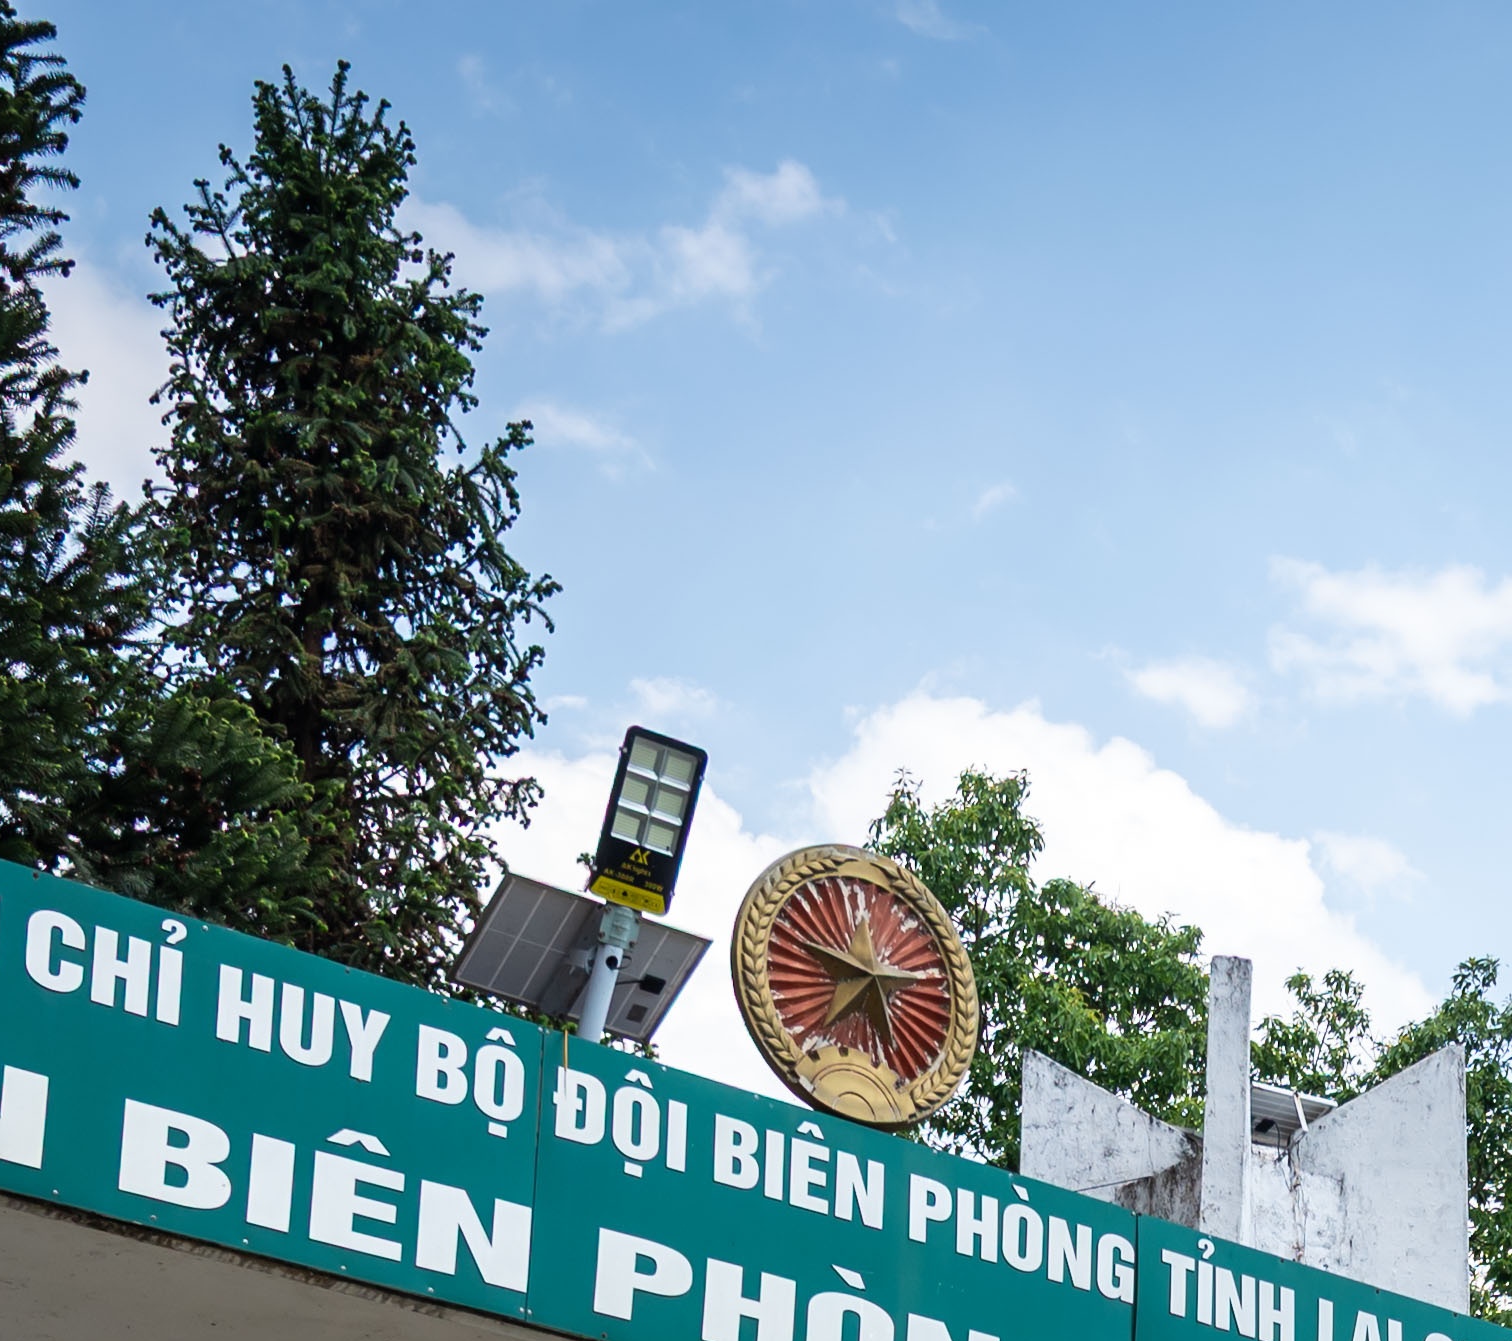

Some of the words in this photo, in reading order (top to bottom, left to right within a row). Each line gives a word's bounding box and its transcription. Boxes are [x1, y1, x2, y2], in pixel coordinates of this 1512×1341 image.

[26, 910, 187, 1025] CHỈ
[217, 964, 390, 1081] HUY
[417, 1024, 524, 1137] BỘ
[553, 1048, 687, 1177] ĐỘI
[714, 1114, 884, 1229] BIÊN
[909, 1174, 1135, 1303] PHÒNG
[119, 1099, 532, 1292] BIÊN
